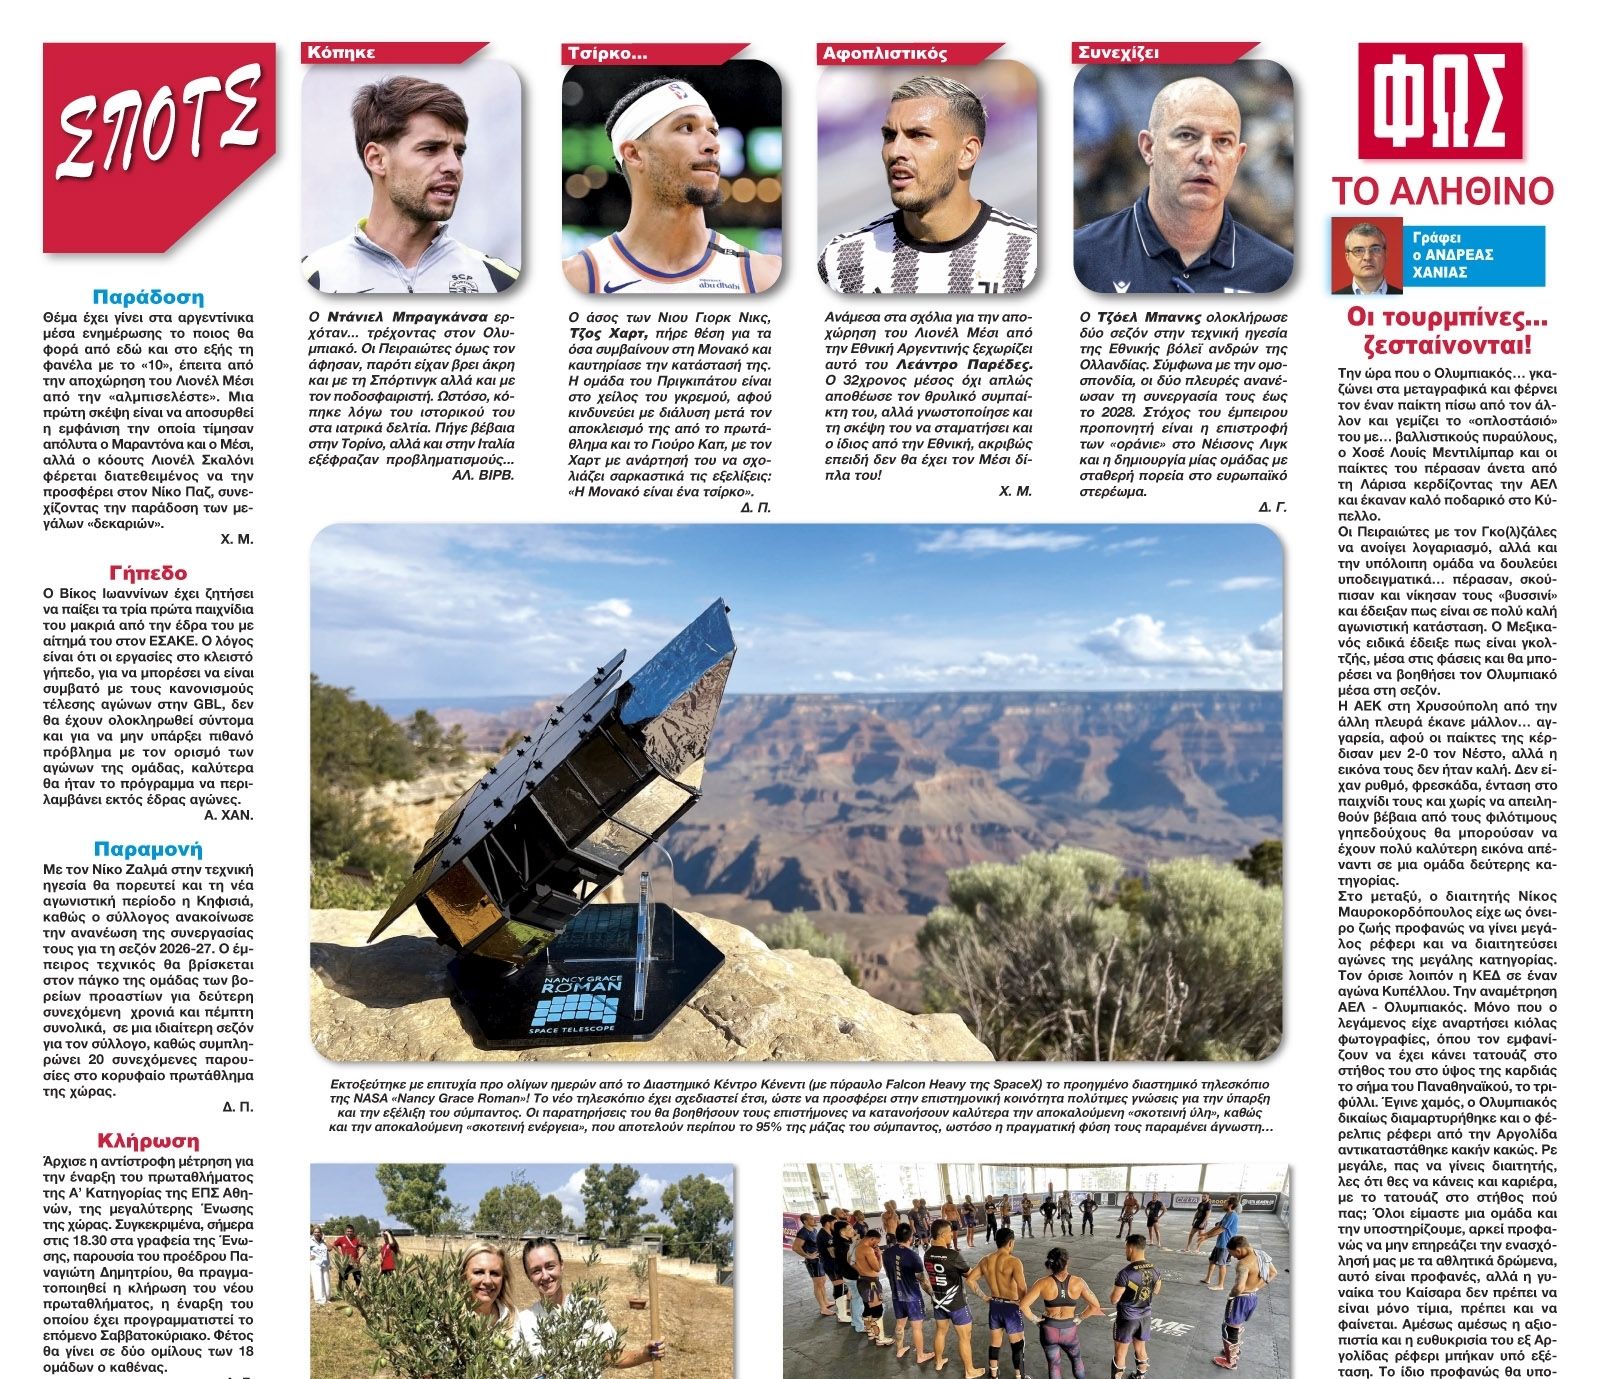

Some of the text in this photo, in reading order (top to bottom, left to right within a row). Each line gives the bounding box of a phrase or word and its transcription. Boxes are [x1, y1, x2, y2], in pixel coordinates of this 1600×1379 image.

[308, 45, 375, 62] Κόπηκε
[823, 46, 948, 63] Αφοπλιστικός
[1078, 45, 1159, 62] Συνεχίζει
[1372, 53, 1508, 149] ΦΩΣ
[1331, 175, 1555, 206] ΤΟ ΑΛΗΘΙΝΟ
[1413, 231, 1461, 246] Γράφει
[1413, 248, 1494, 261] ο ΑΝΔΡΕΑΣ
[451, 273, 473, 281] SCP
[1413, 266, 1468, 278] ΧΑΝΙΑΣ
[716, 282, 740, 290] dhabi
[92, 288, 205, 309] Παράδοση
[308, 310, 515, 325] Ο Ντάνιελ Μπραγκάνσα ερ-
[1079, 311, 1289, 326] Ο Τζόελ Μπανκς ολοκλήρωσε
[1347, 305, 1374, 327] Οι
[1363, 334, 1532, 360] ζεσταίνονται!
[824, 358, 1033, 373] αυτό του Λεάντρο Παρέδες.
[568, 485, 755, 500] «Η Μονακό είναι ένα τσίρκο».
[42, 517, 165, 532] γάλων «δεκαριών».
[1337, 525, 1558, 540] Οι Πειραιώτες με τον Γκο(λ)ζάλες
[109, 564, 188, 585] Γήπεδο
[42, 698, 254, 712] τέλεσης αγώνων στην GBL, δεν
[94, 840, 203, 861] Παραμονή
[42, 894, 254, 909] αγωνιστική περίοδο η Κηφισιά,
[541, 982, 622, 994] ROMAN
[528, 1025, 615, 1035] SPACE TELESCOPE
[97, 1132, 200, 1153] Κλήρωση
[42, 1329, 254, 1344] επόμενο Σαββατοκύριακο. Φέτος
